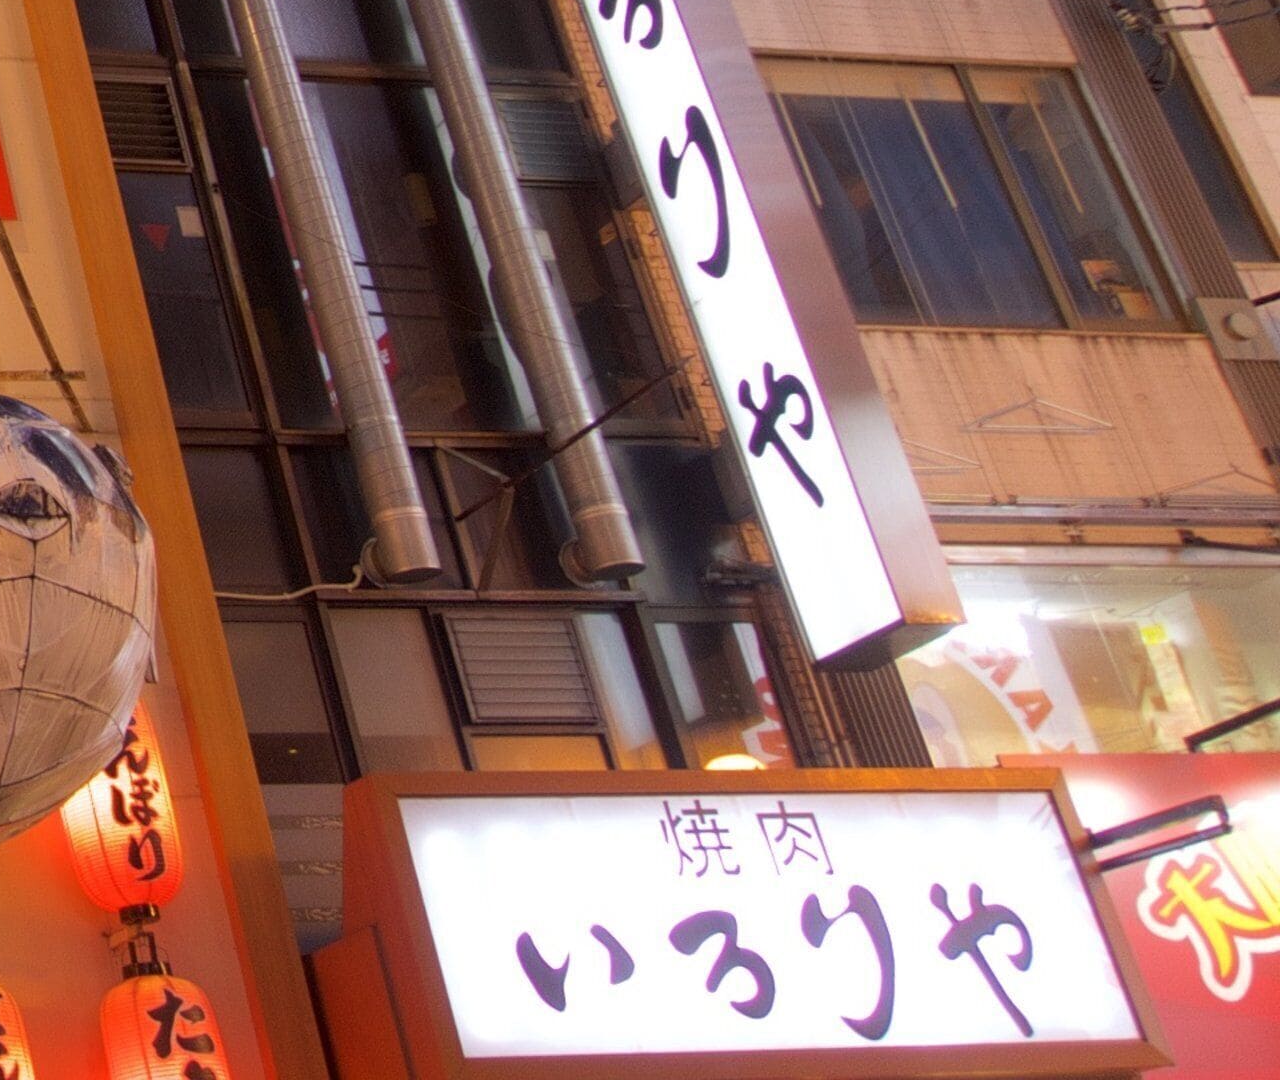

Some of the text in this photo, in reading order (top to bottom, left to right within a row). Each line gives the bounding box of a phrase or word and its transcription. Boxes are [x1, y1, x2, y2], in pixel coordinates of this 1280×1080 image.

[105, 715, 166, 883] んぼり
[660, 799, 835, 879] 焼肉
[515, 882, 1034, 1042] いろりや
